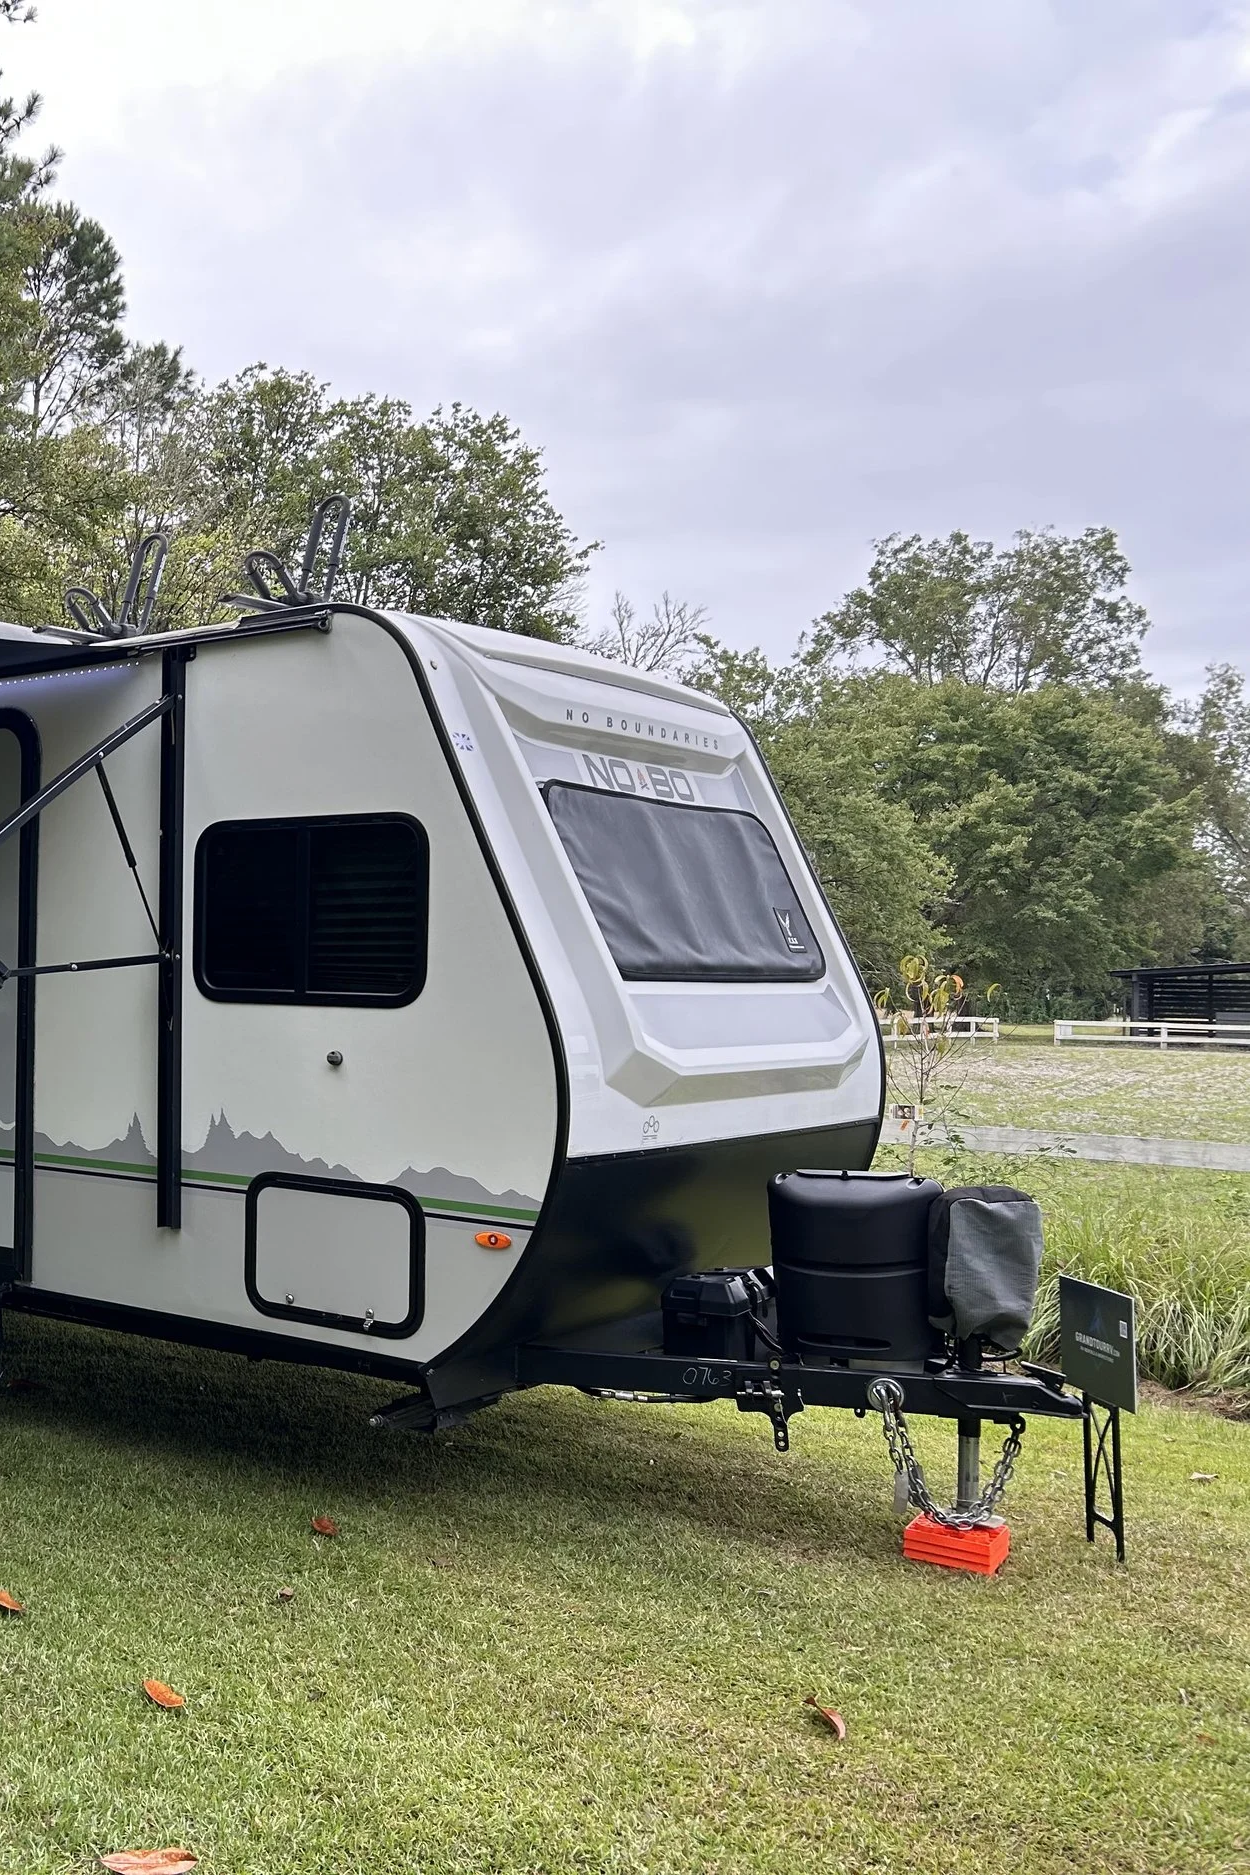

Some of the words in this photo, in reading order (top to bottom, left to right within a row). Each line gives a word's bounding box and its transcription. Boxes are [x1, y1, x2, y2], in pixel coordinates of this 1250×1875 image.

[566, 709, 589, 724] NO
[607, 716, 719, 750] BOUNDARIES
[682, 1366, 732, 1387] 0763
